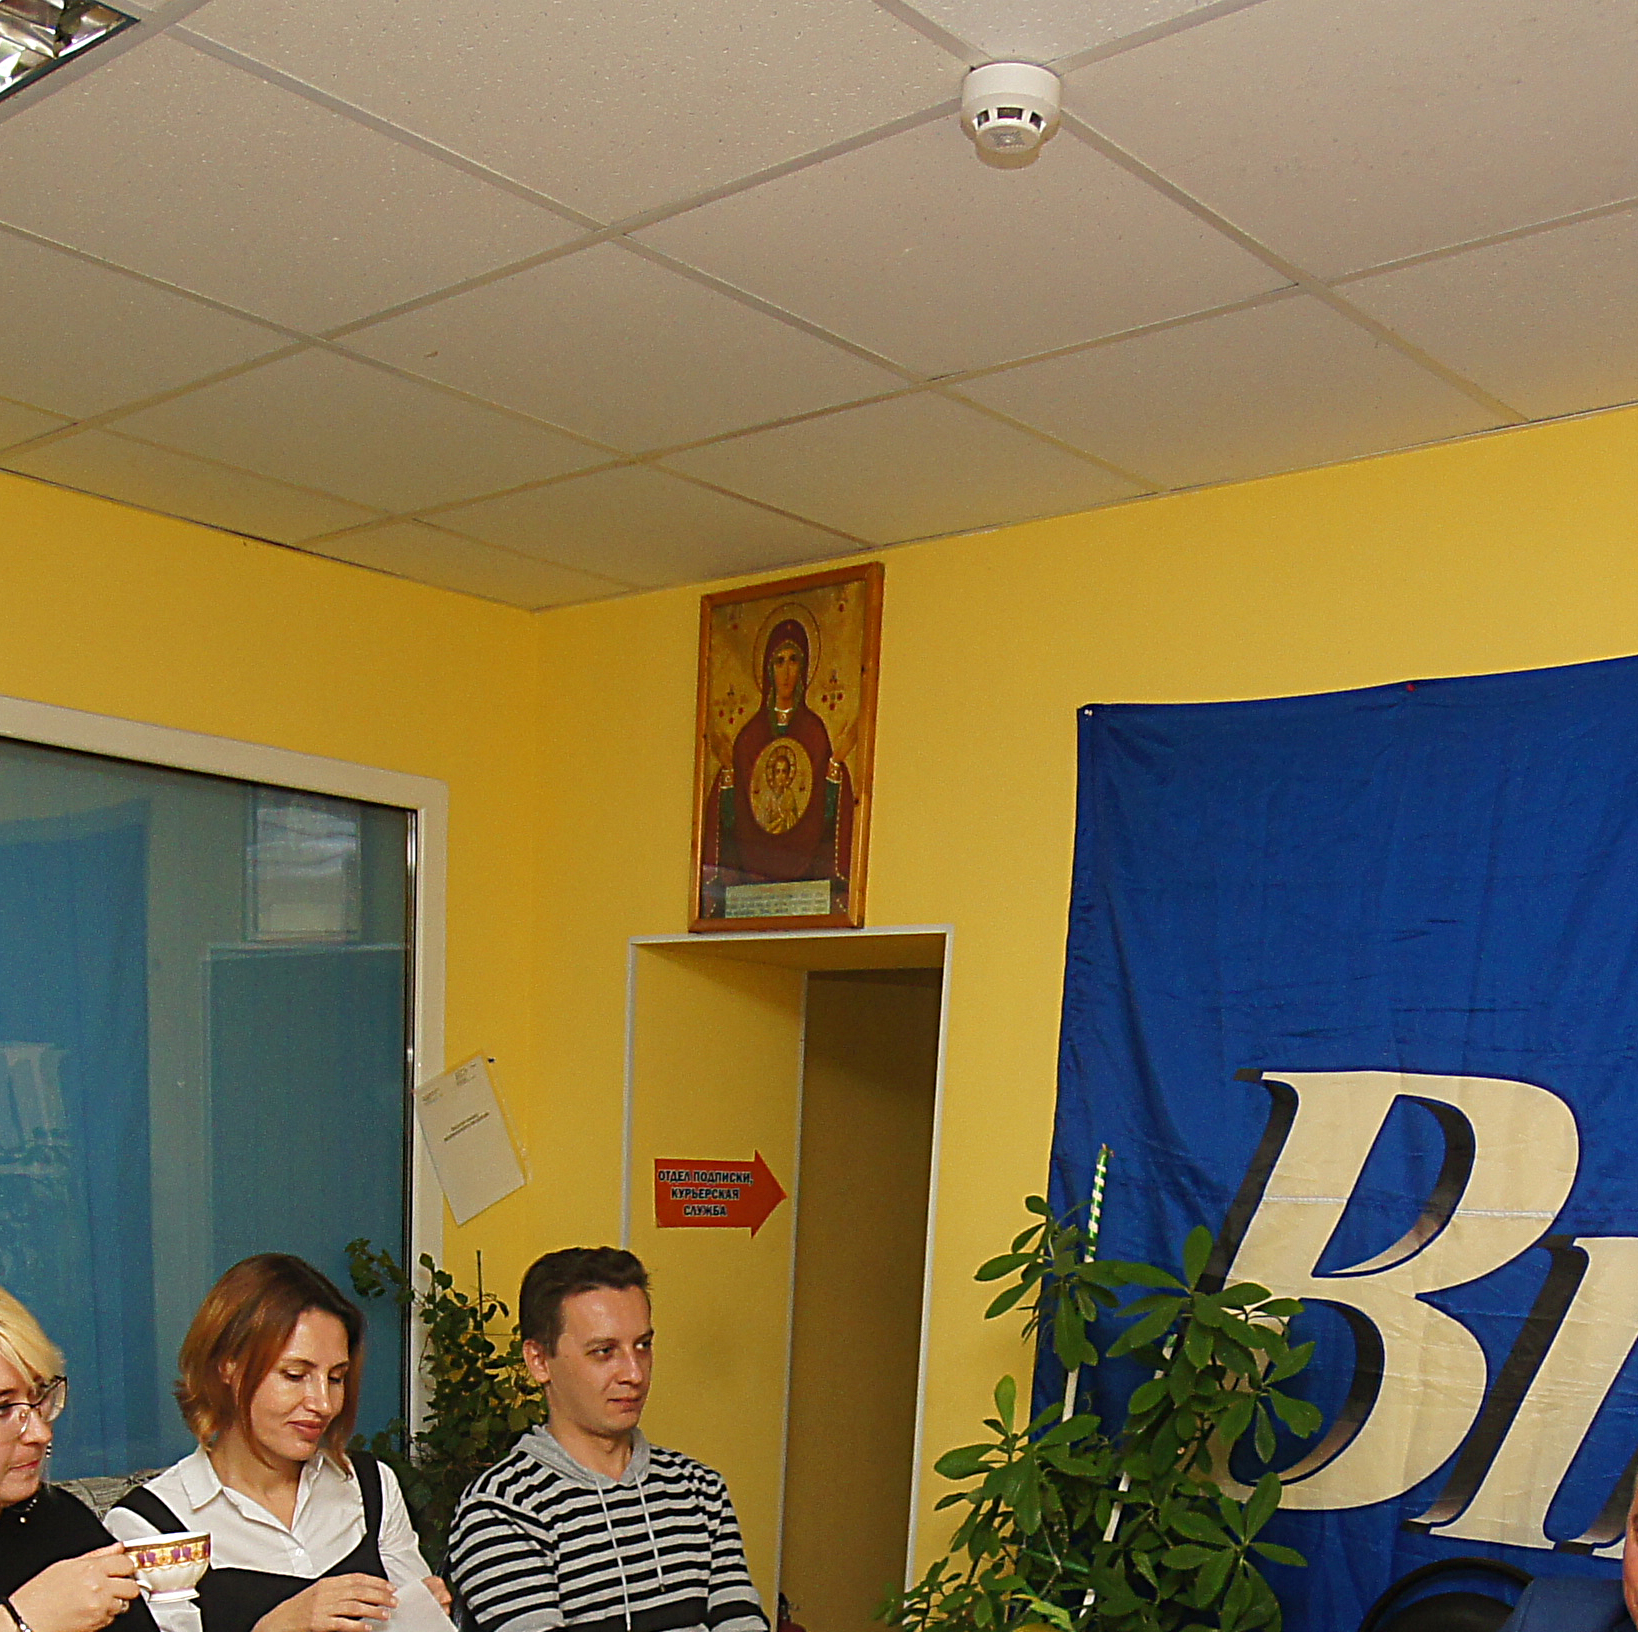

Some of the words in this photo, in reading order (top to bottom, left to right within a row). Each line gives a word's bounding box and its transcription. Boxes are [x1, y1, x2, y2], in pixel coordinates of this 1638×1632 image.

[658, 1170, 691, 1184] ОТДЕЛ
[694, 1170, 754, 1186] ПОДПИСКИ,
[671, 1187, 740, 1200] КУРЬЕРСКАЯ
[683, 1204, 727, 1217] СЛУЖБА
